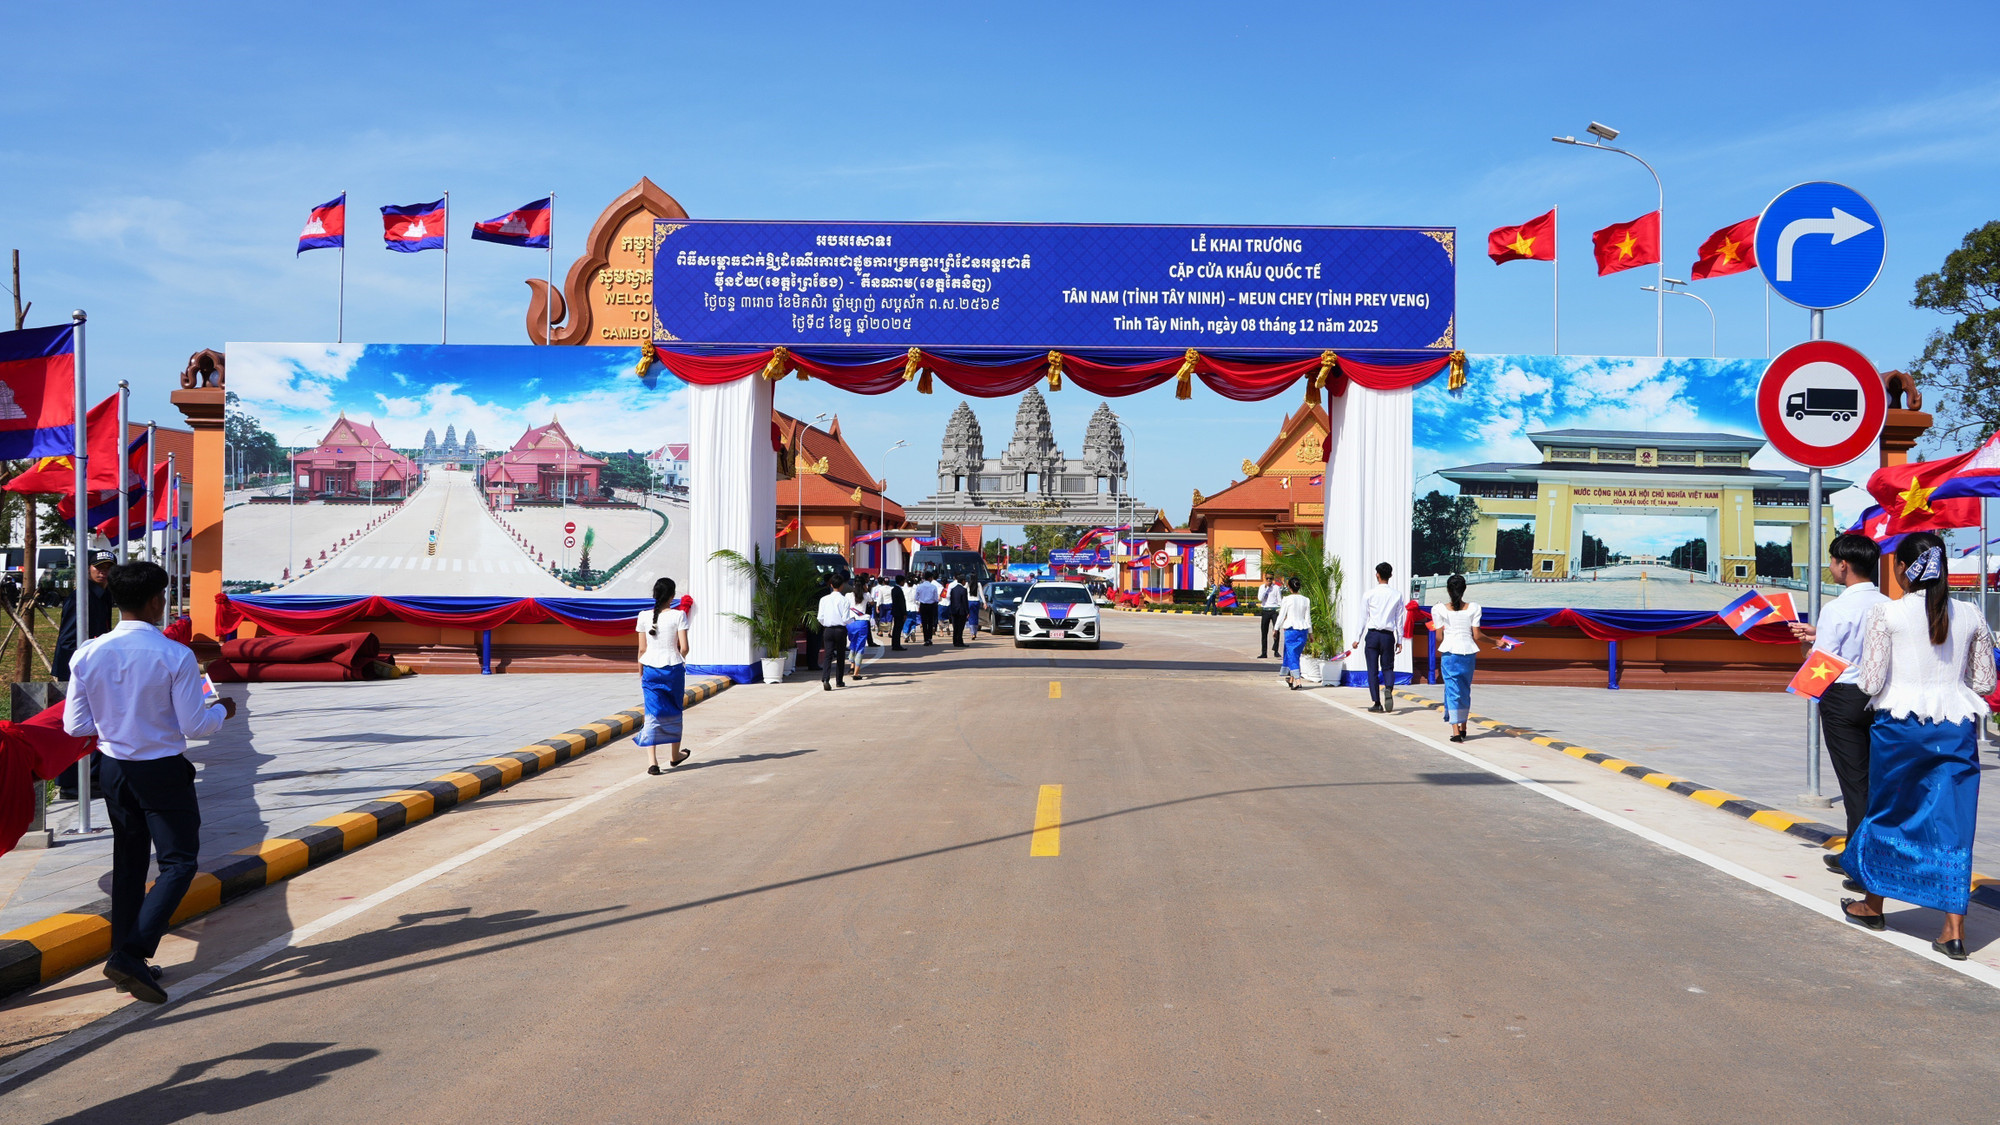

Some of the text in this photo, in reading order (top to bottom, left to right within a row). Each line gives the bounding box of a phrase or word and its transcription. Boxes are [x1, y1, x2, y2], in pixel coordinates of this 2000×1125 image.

[816, 235, 892, 247] អបអរសាទរ
[1191, 233, 1302, 253] LỄ KHAI TRƯƠNG
[1168, 261, 1322, 282] CẶP CỬA KHẨU QUỐC TẾ
[604, 293, 652, 305] WELCO
[704, 292, 736, 311] ថ្ងៃចន្ទ
[741, 296, 774, 308] ៣រោច
[778, 293, 828, 309] ខែមិគសិរ
[832, 294, 876, 312] ឆ្នាំម្សាញ់
[929, 297, 1000, 310] ព.ស.២៥៦៩
[1062, 288, 1088, 304] TÂN
[1090, 290, 1119, 304] NAM
[1122, 289, 1159, 307] (TỈNH
[1161, 289, 1185, 305] TÂY
[1187, 290, 1226, 307] NINH)
[1238, 292, 1276, 306] MEUN
[1279, 292, 1313, 306] CHEY
[1315, 290, 1352, 308] (TỈNH
[1355, 293, 1388, 307] PREY
[1389, 293, 1430, 310] VENG)
[631, 310, 649, 321] TO
[792, 313, 912, 337] ថ្ងៃទី៨ ខែធ្នូ ឆ្នាំ២០២៥
[1113, 315, 1379, 335] Tỉnh Tây Ninh, ngày 08 tháng 12 năm 2025
[601, 327, 650, 339] CAMBO
[1593, 488, 1611, 497] CỘNG
[1613, 488, 1626, 497] HÒA
[1639, 489, 1649, 498] HỘI
[1688, 490, 1702, 500] VIỆT
